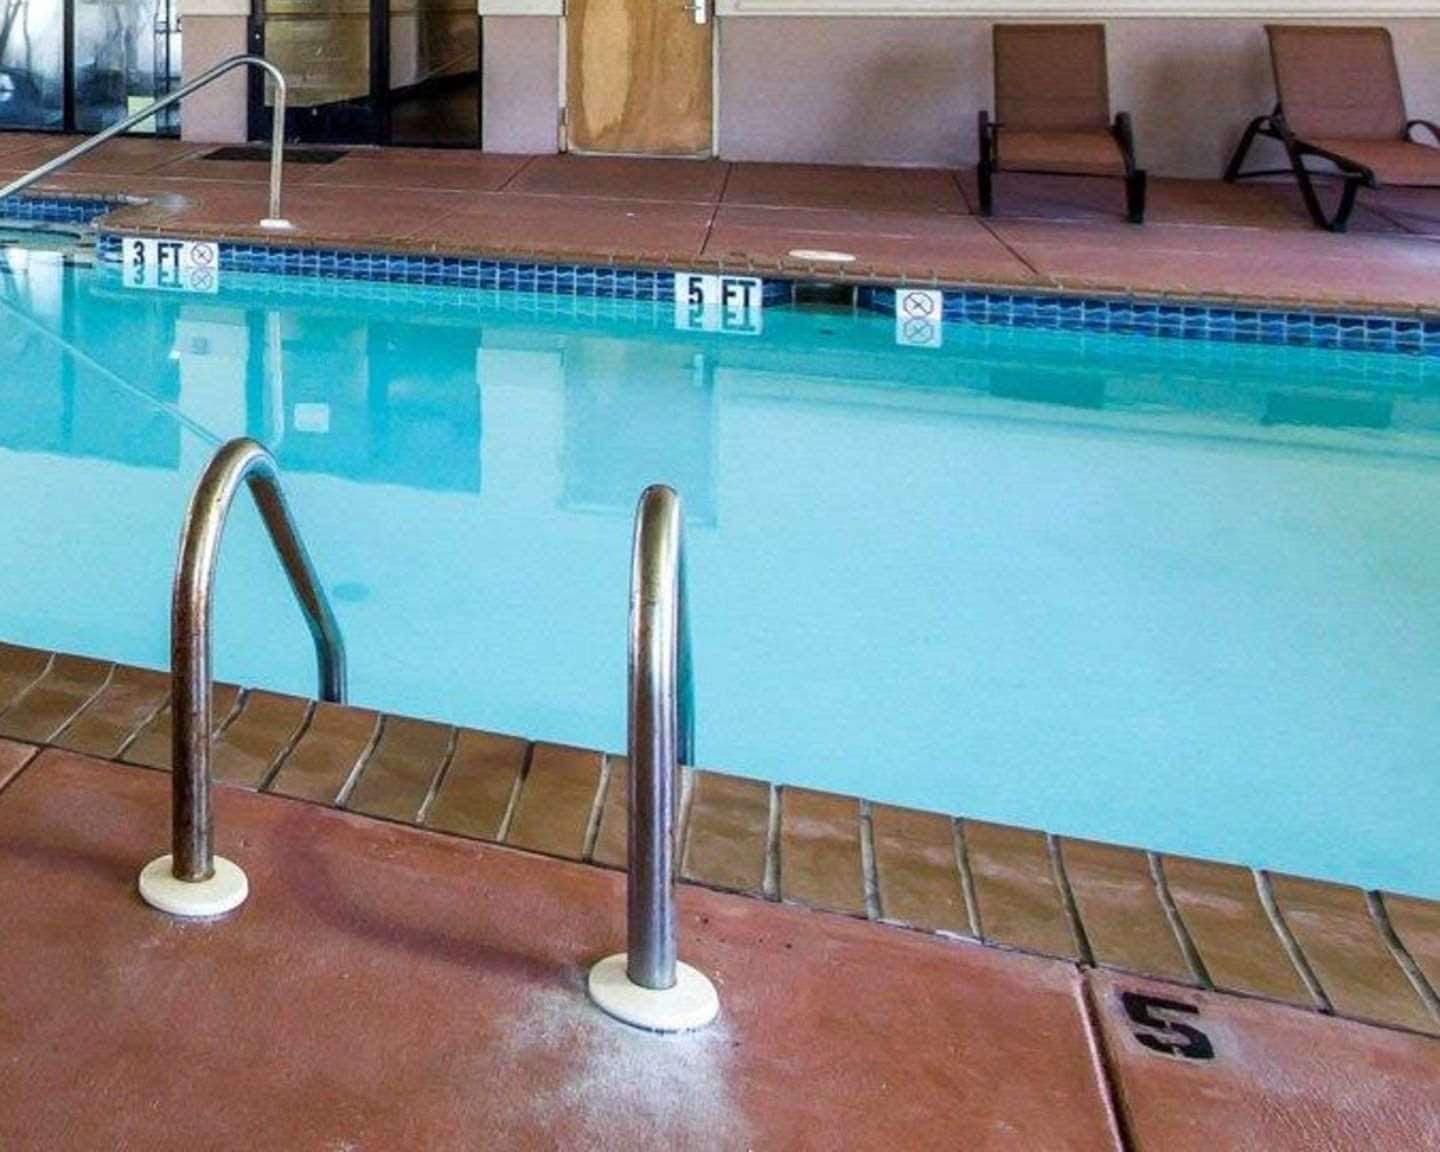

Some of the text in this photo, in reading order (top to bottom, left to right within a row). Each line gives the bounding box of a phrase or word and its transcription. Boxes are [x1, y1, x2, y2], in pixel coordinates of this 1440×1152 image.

[133, 240, 184, 267] 3 FT
[688, 277, 757, 307] 5 FT
[1120, 991, 1216, 1060] 5
